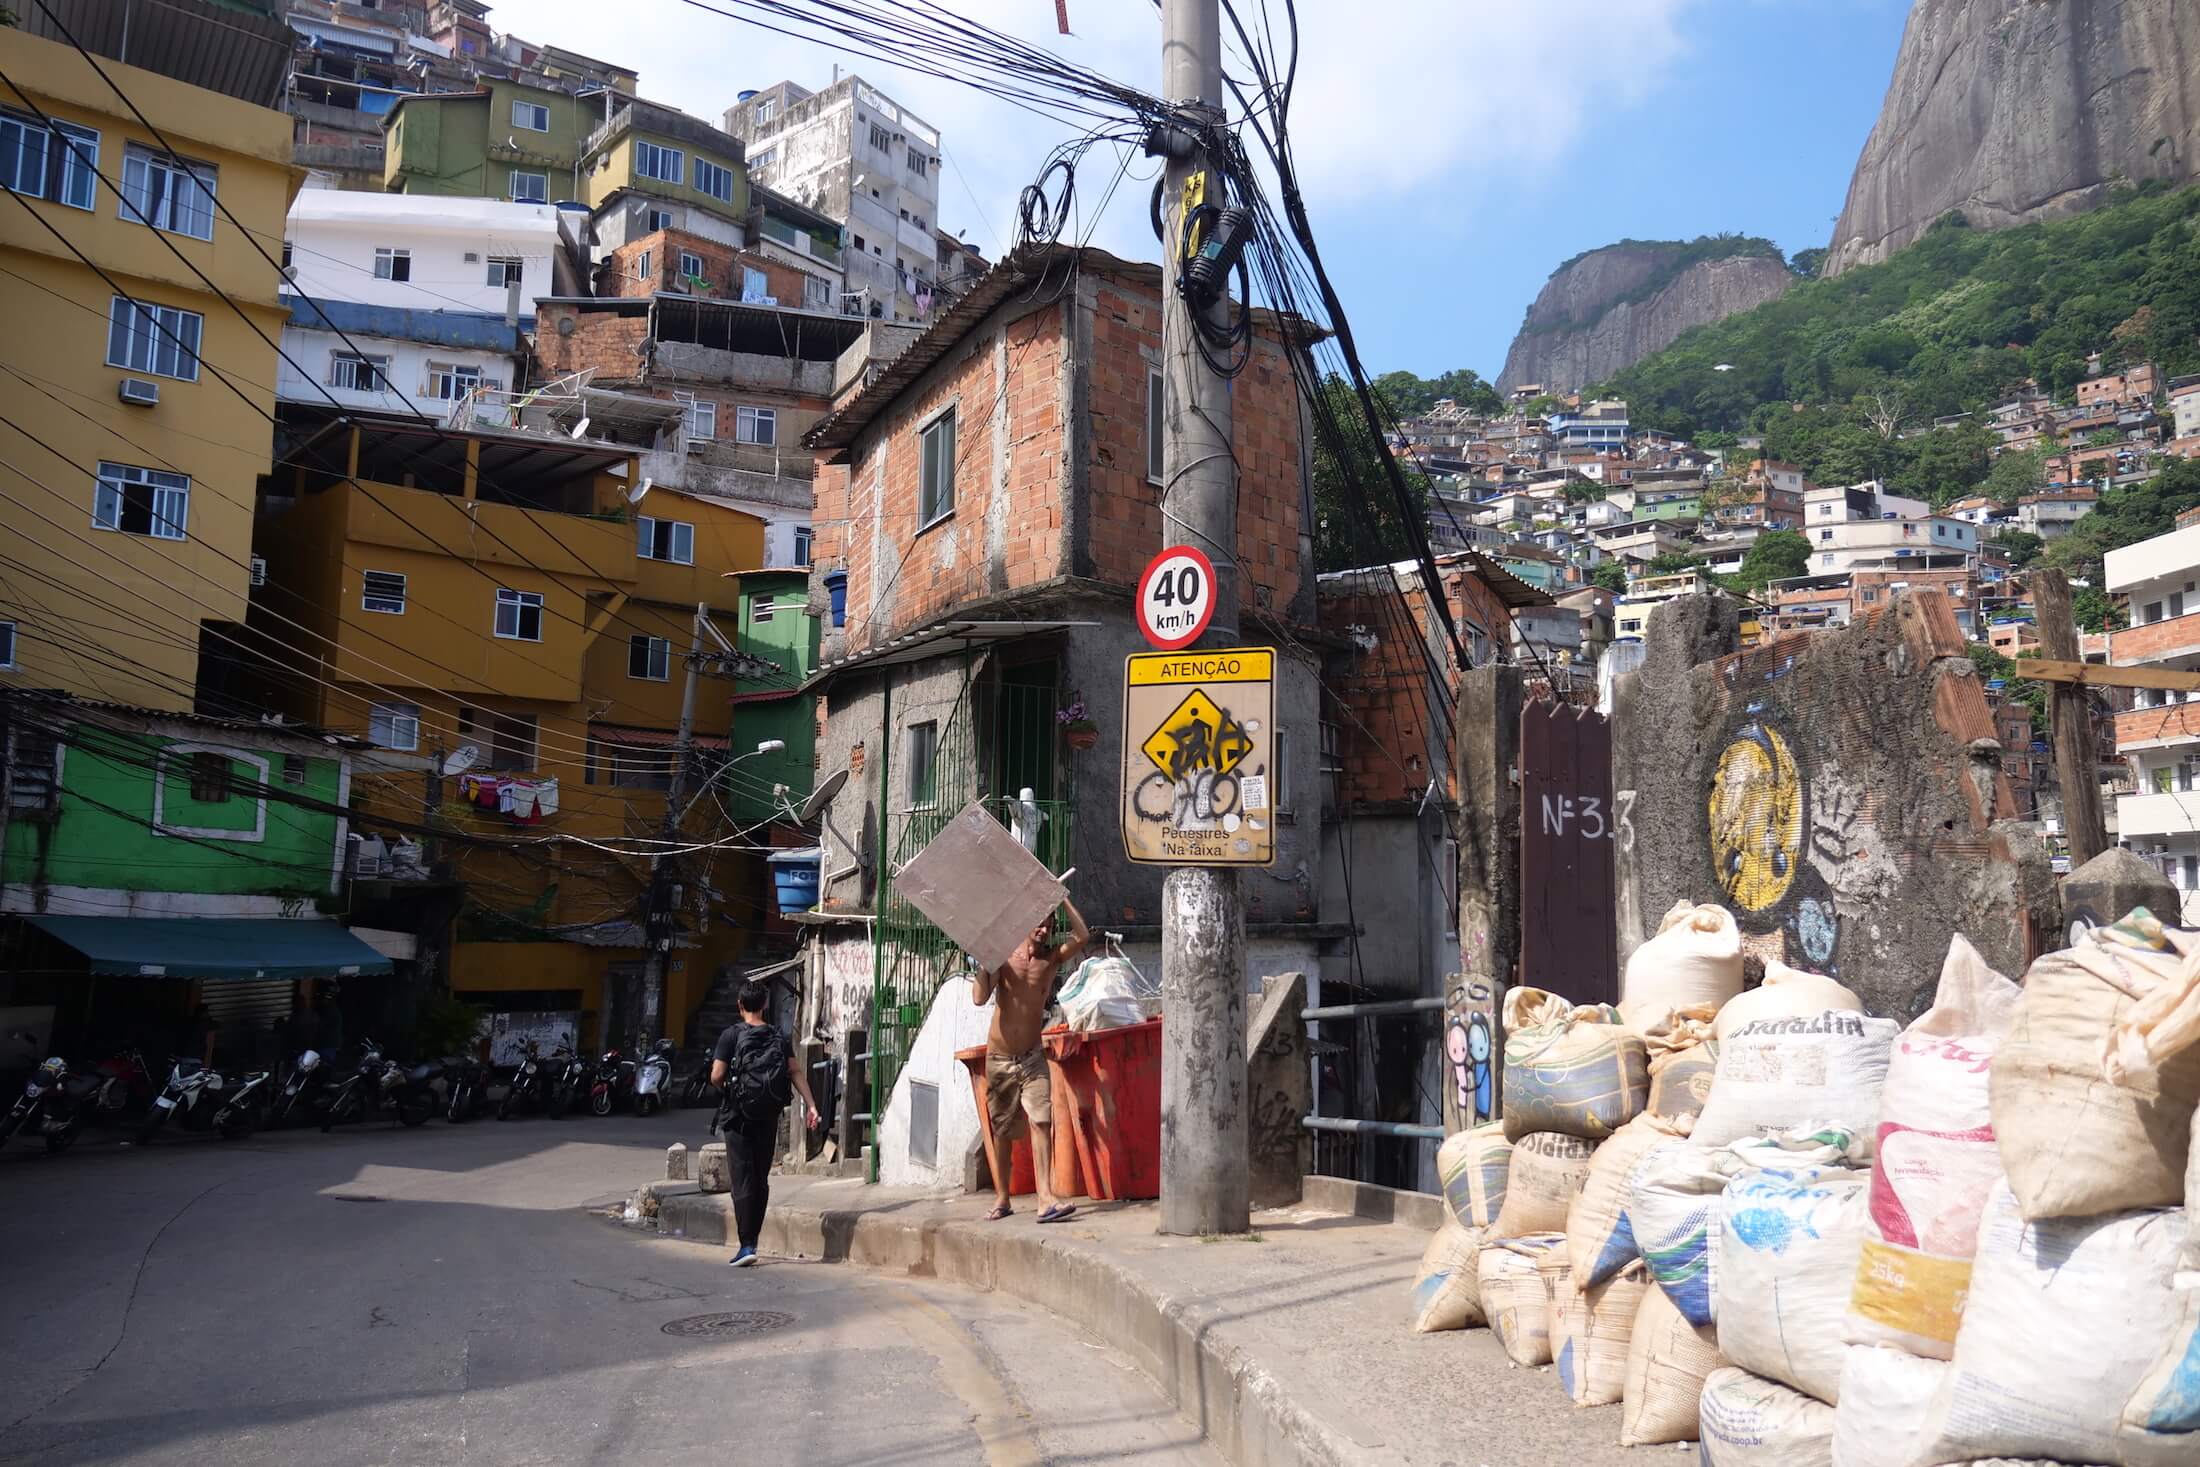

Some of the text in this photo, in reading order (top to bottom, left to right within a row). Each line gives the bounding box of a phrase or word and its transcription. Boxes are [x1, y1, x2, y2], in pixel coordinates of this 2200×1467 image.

[1153, 566, 1200, 608] 40
[1156, 610, 1195, 630] km/h
[1160, 657, 1241, 680] ATENÇÃO
